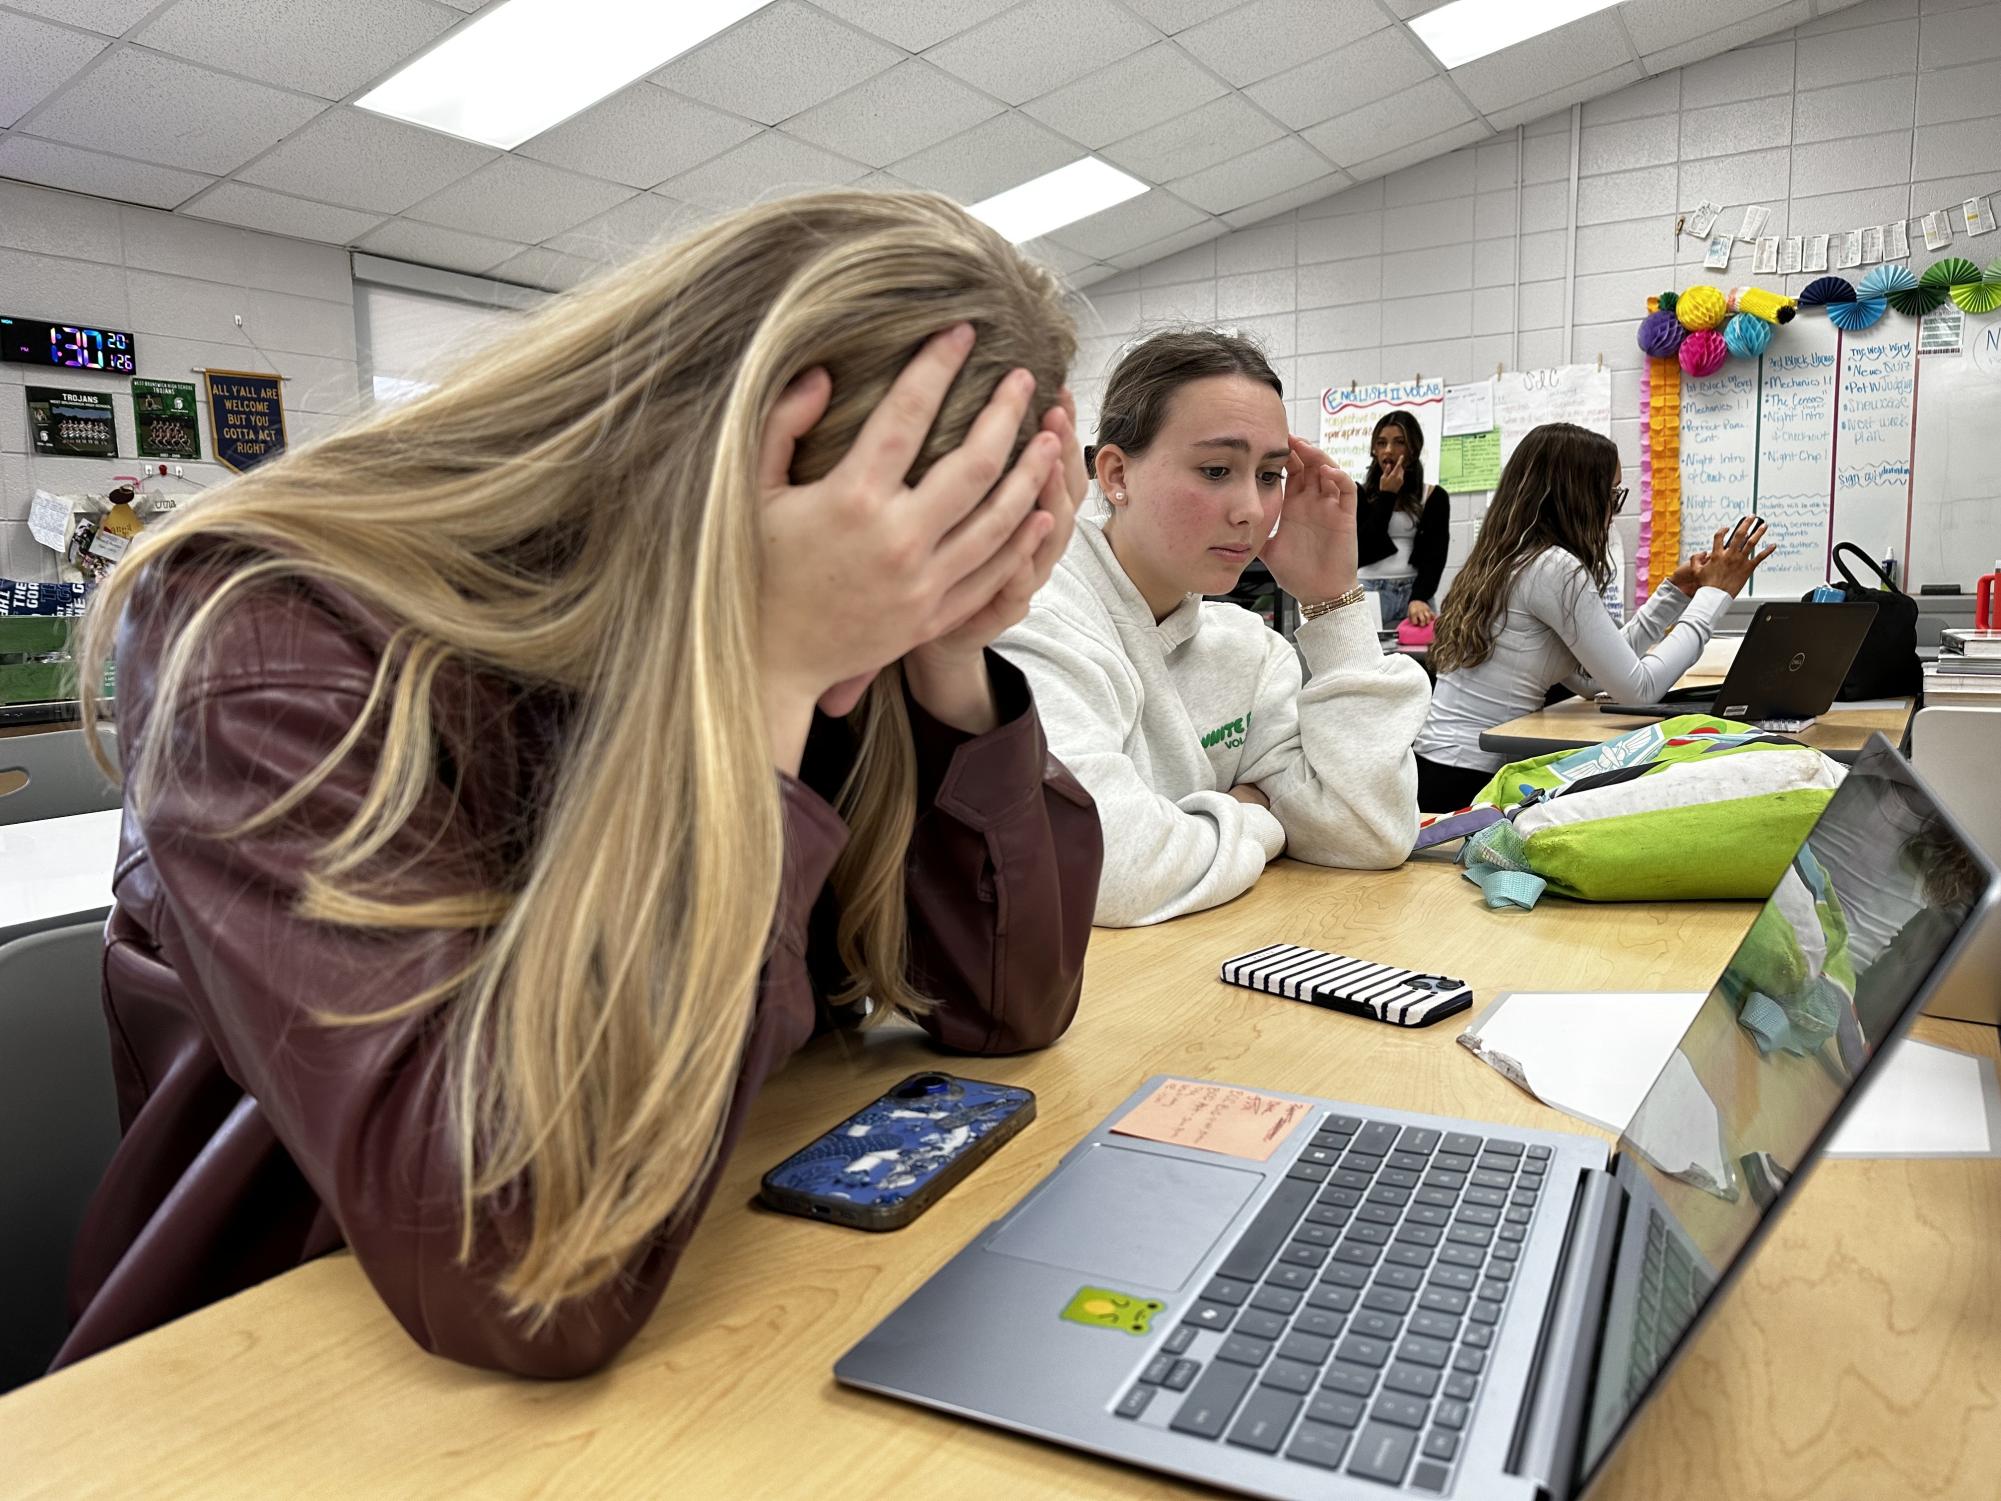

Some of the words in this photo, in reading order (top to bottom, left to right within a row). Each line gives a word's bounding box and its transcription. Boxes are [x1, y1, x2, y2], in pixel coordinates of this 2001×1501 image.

[50, 326, 104, 369] 1:30
[62, 393, 98, 404] TROJANS
[212, 384, 229, 396] ALL
[231, 385, 257, 398] Y'ALL
[260, 387, 278, 400] ARE
[1326, 387, 1389, 410] ENGLISH
[1390, 388, 1401, 401] II
[1403, 384, 1441, 398] VOCAB
[224, 399, 270, 413] WELCOME
[227, 413, 246, 426] BUT
[249, 415, 269, 427] YOU
[223, 428, 255, 440] GOTTA
[258, 430, 276, 441] ACT
[236, 442, 266, 454] RIGHT
